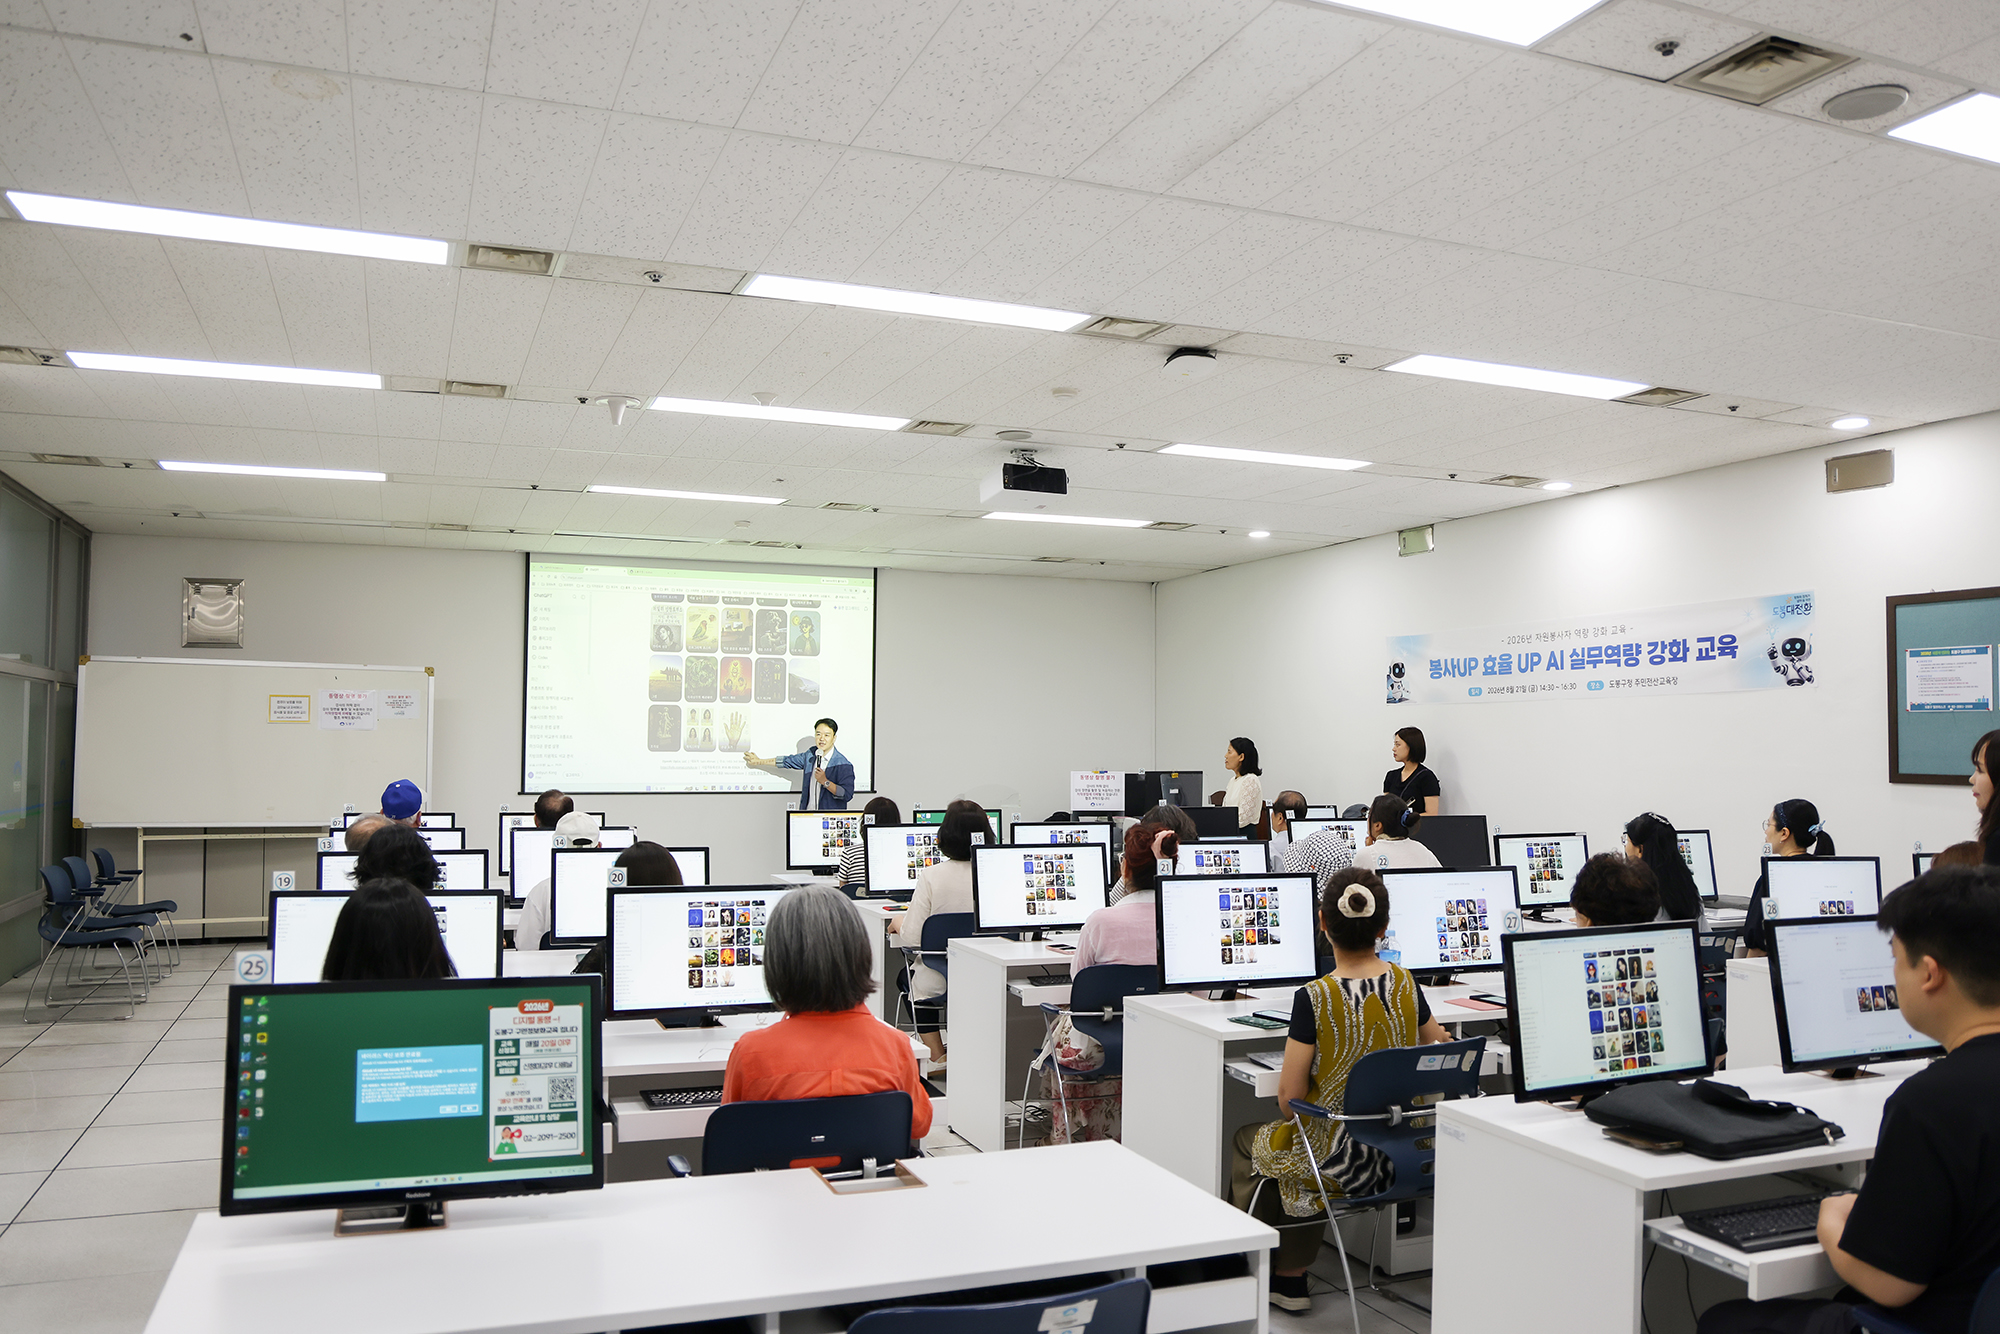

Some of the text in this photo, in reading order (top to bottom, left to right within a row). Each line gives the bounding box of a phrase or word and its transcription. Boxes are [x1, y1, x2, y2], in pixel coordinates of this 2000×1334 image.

[1507, 634, 1532, 645] 2026년
[1535, 628, 1571, 643] 자원봉사자
[1574, 627, 1589, 639] 역량
[1592, 625, 1607, 638] 강화
[1610, 624, 1626, 635] 교육
[1429, 634, 1739, 680] 봉사UP 효율 UP AI 실무역량 강화 교육
[1487, 687, 1505, 695] 2026년
[1506, 686, 1515, 694] 8월
[1515, 685, 1527, 693] 21일
[1528, 684, 1538, 693] (금)
[1561, 682, 1576, 690] 16:30
[1609, 678, 1633, 689] 도봉구청
[1634, 676, 1678, 688] 주민전산교육장
[974, 835, 982, 843] 15
[1764, 846, 1771, 854] 23
[1379, 858, 1387, 866] 22
[1161, 863, 1169, 872] 21
[278, 877, 290, 886] 19
[612, 873, 623, 882] 20
[1767, 904, 1777, 914] 28
[1506, 917, 1517, 928] 27
[243, 960, 264, 975] 25
[523, 1002, 549, 1012] 2026년
[513, 1016, 535, 1025] 디지털
[495, 1028, 514, 1036] 도봉구
[541, 1039, 556, 1048] 20일
[523, 1132, 577, 1142] 02-2091-2500
[405, 1191, 431, 1199] Redstone
